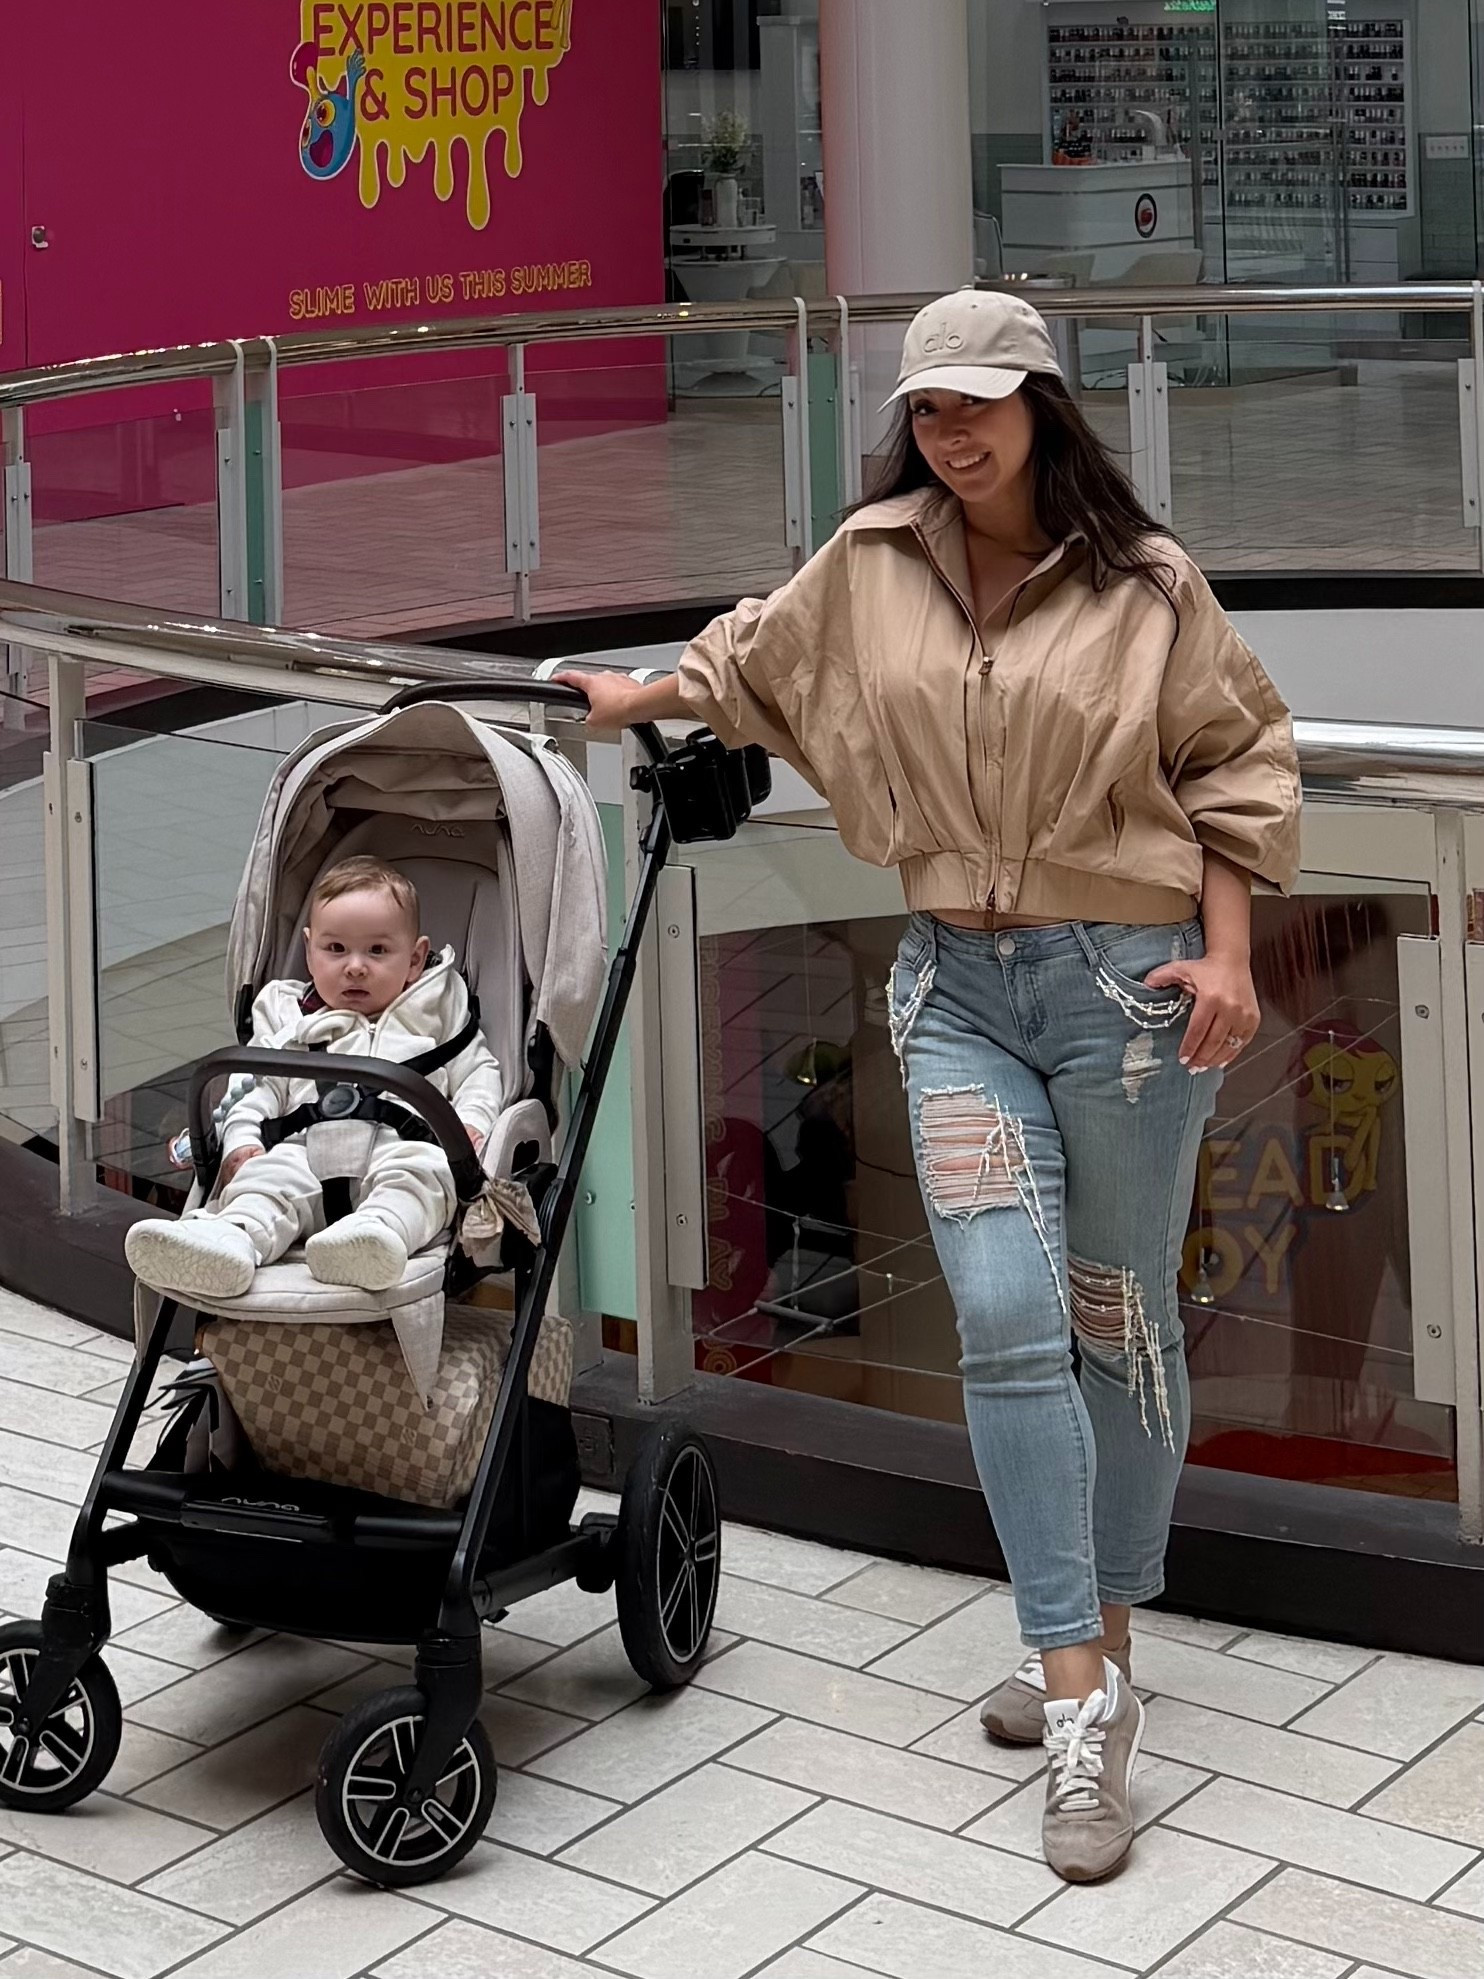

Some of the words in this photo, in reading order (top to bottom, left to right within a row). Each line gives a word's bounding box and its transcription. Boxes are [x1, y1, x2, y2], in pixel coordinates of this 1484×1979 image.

[312, 1, 554, 56] EXPERIENCE
[360, 68, 389, 122] &
[404, 64, 514, 119] SHOP
[289, 284, 355, 319] SLIME
[364, 278, 419, 310] WITH
[425, 274, 454, 303] US
[459, 268, 505, 299] THIS
[510, 259, 592, 294] SUMMER
[923, 322, 964, 353] alo
[1199, 1135, 1366, 1210] EAD
[1180, 1225, 1297, 1296] OY
